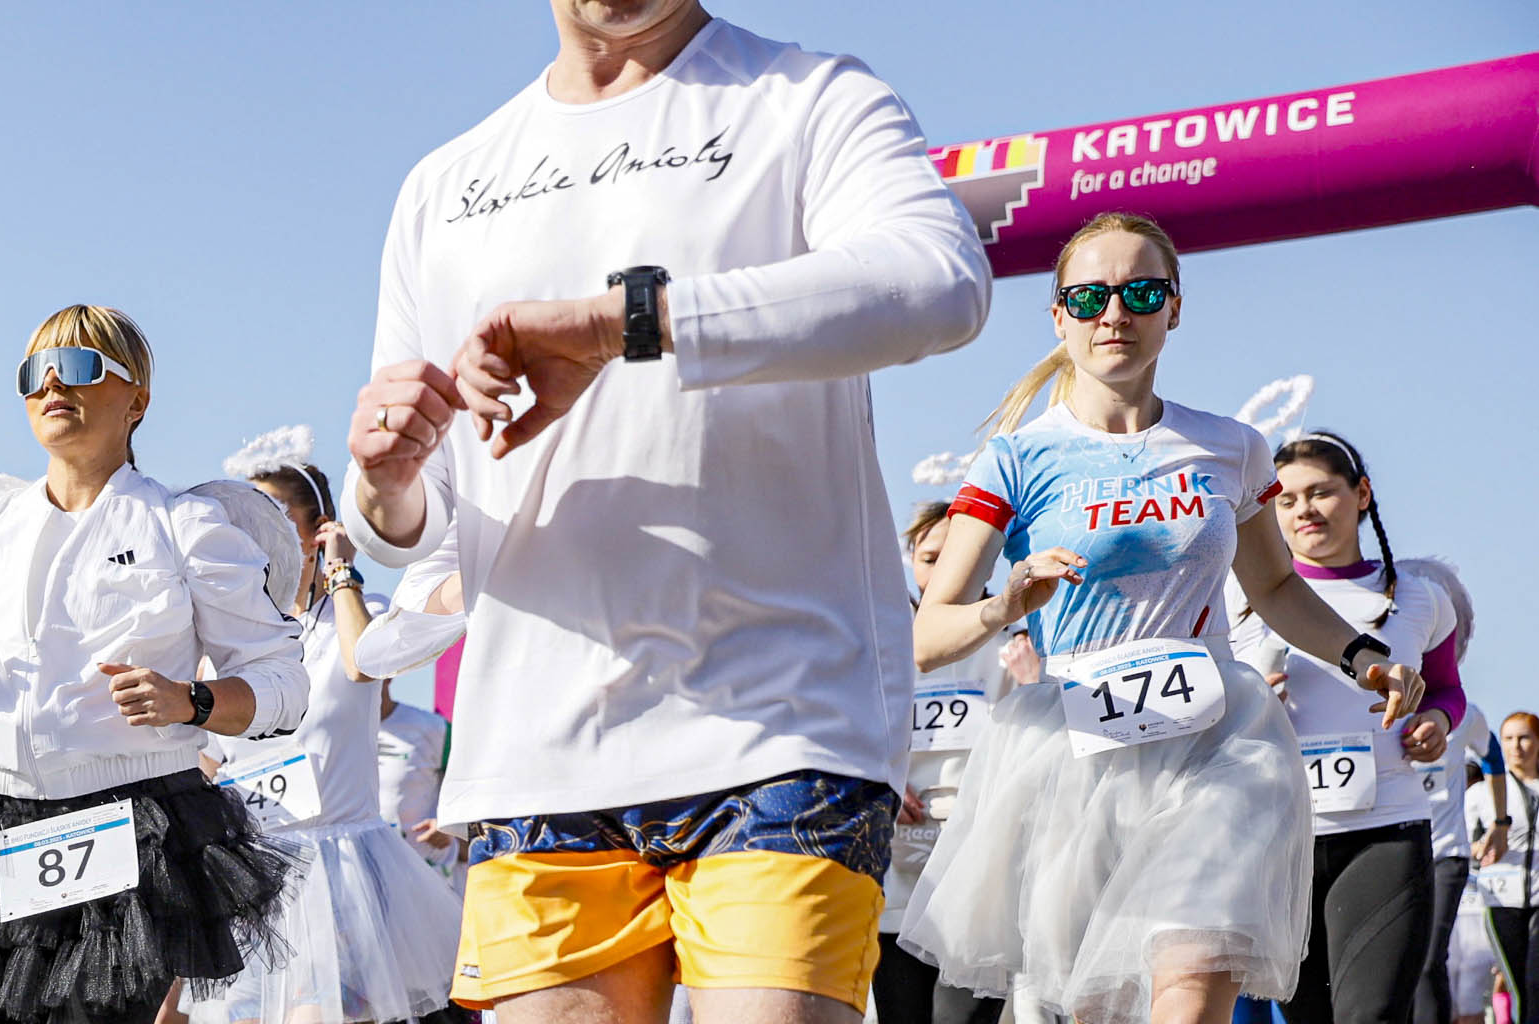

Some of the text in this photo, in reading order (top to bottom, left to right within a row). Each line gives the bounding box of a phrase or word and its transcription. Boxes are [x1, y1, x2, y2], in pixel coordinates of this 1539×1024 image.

[1072, 91, 1356, 163] KATOWICE
[1070, 156, 1217, 201] for a change
[1062, 473, 1214, 512] HERNIK
[1084, 495, 1205, 531] TEAM
[1091, 664, 1195, 722] 174
[246, 774, 287, 810] 49
[1309, 757, 1355, 789] 19
[38, 839, 95, 887] 87
